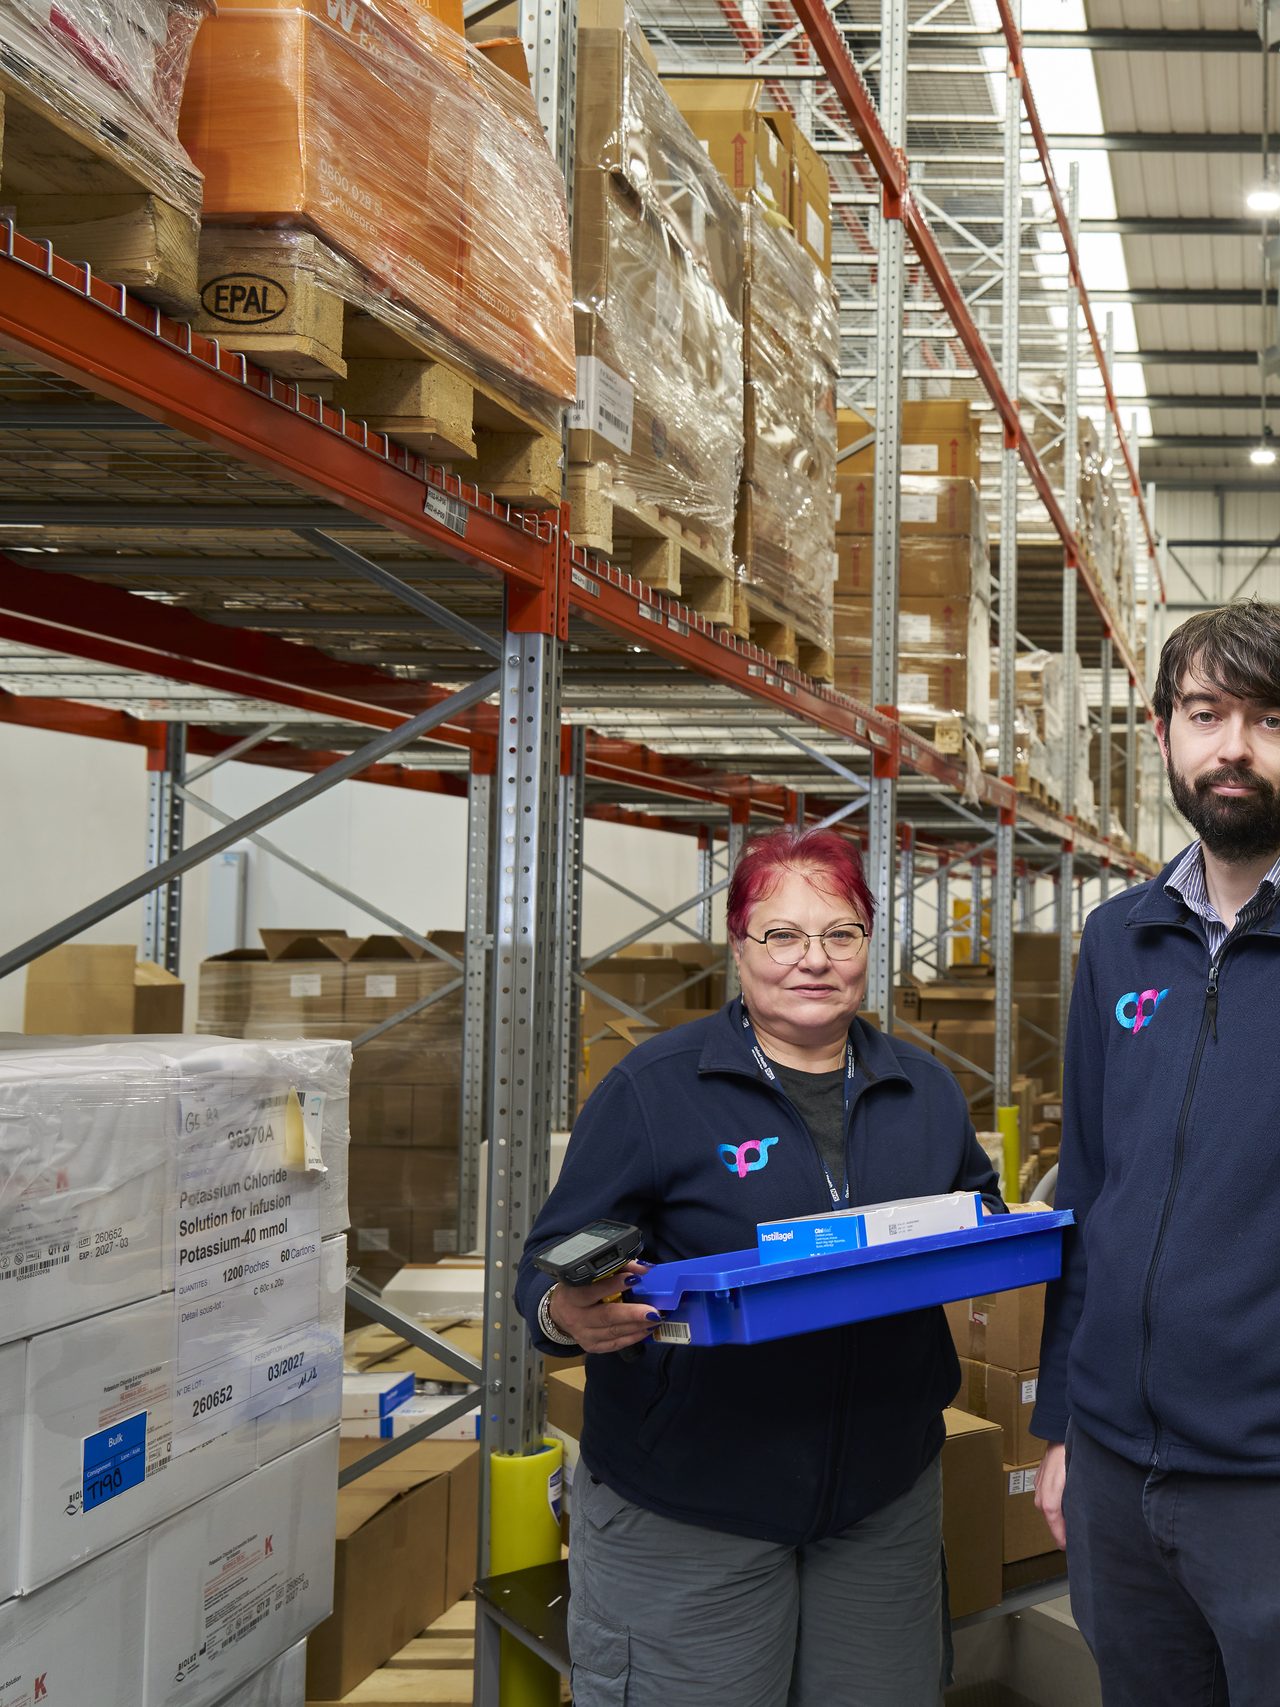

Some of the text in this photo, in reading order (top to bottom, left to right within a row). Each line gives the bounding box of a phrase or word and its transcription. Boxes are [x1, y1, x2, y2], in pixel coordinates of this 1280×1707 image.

[215, 285, 276, 314] EPAL
[179, 1182, 241, 1208] Potassium
[244, 1168, 288, 1191] Chloride
[179, 1194, 291, 1237] Solution for Infusion
[95, 1227, 122, 1244] 260652
[179, 1218, 288, 1266] Potassium-40 mmol
[762, 1230, 793, 1241] Instillagel
[96, 1242, 114, 1258] 2027
[223, 1243, 316, 1283] 1200 Poches 60 Cartons
[268, 1352, 305, 1382] 03/2027
[183, 1385, 191, 1394] DE
[192, 1384, 233, 1418] 260652
[108, 1433, 123, 1448] Bulk
[87, 1461, 112, 1478] Consignment
[264, 1534, 273, 1555] K
[34, 1672, 47, 1699] K
